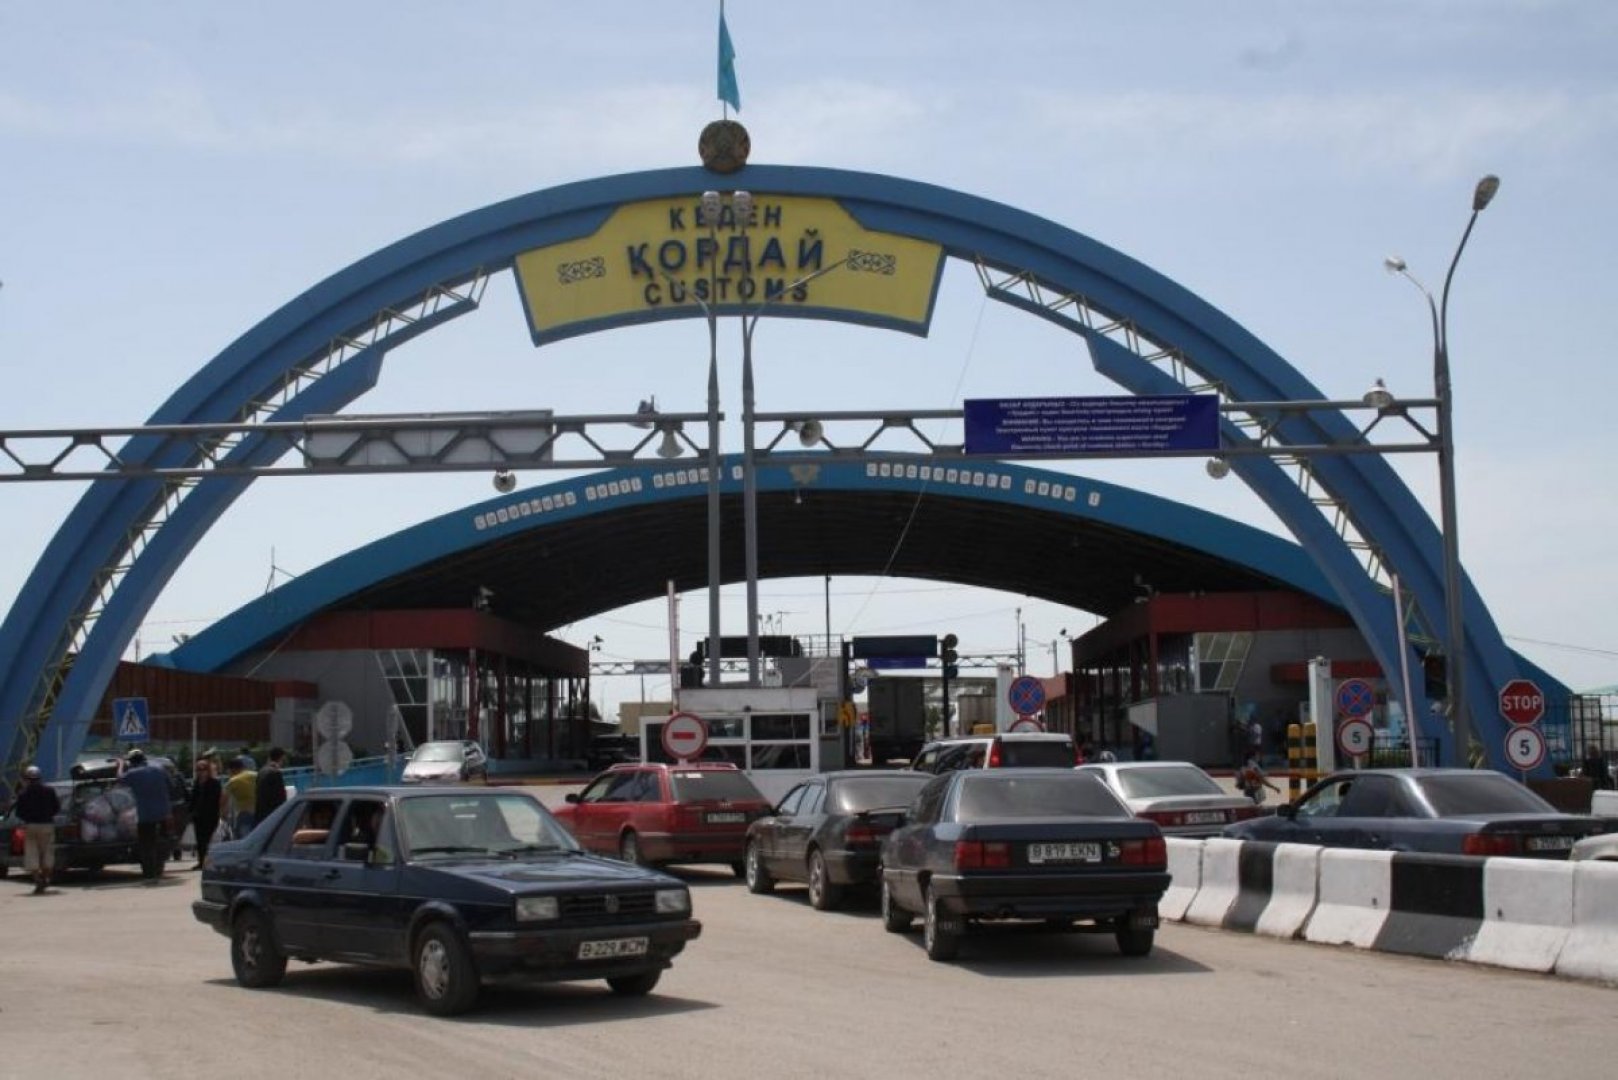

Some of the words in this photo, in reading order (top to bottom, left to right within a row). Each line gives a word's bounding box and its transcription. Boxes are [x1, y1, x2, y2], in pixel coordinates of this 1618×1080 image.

[644, 278, 808, 305] CUSTOMS
[1503, 695, 1541, 711] STOP
[1351, 731, 1362, 744] 5
[1519, 739, 1531, 757] 5
